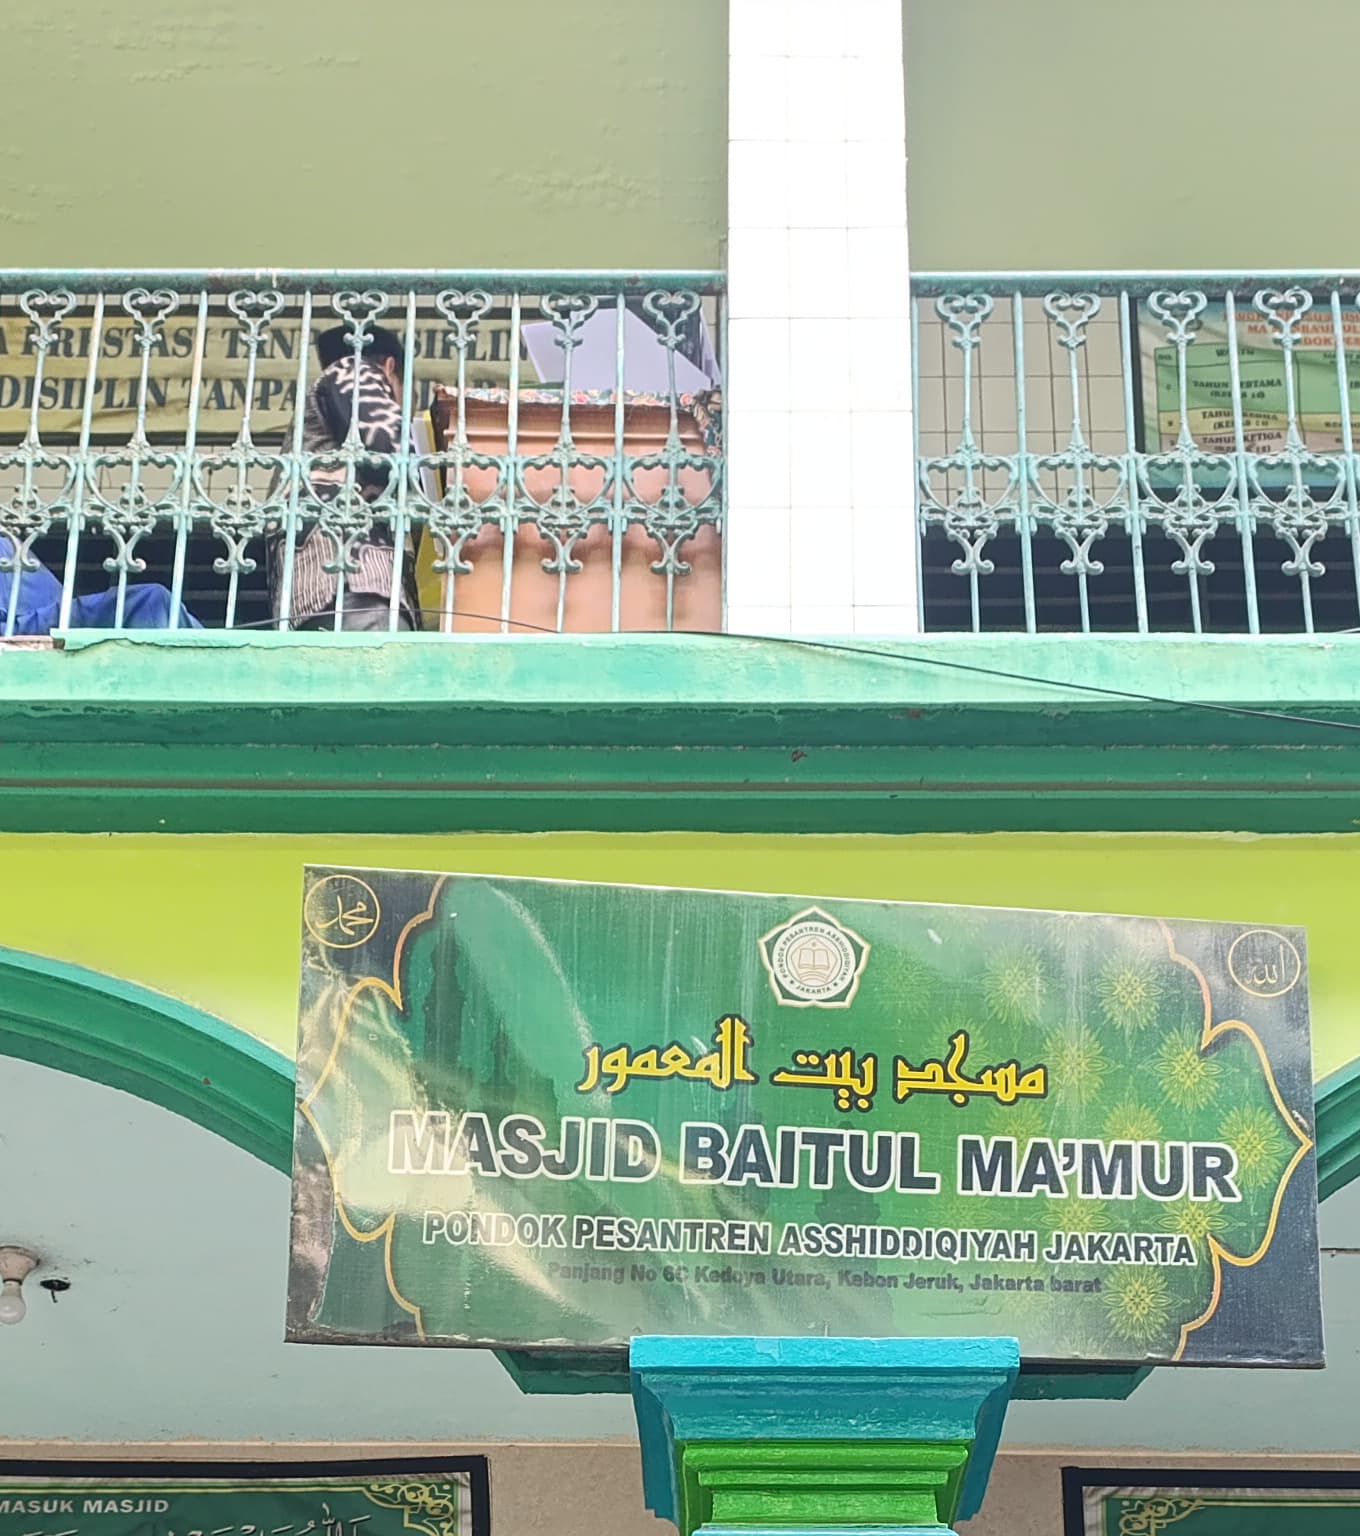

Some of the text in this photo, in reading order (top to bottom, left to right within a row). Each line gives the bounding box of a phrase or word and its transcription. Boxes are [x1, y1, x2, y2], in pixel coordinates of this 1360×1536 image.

[1234, 377, 1283, 388] ERTAMA
[796, 985, 832, 994] JAKARTA
[576, 1014, 1048, 1111] مسجد بيت المعمور
[388, 1110, 661, 1182] MASJID
[679, 1120, 941, 1194] BAITUL
[423, 1210, 1198, 1266] PONDOK PESANTREN ASSHIDDIQIYAH JAKARTA
[547, 1261, 625, 1284] Panjang
[630, 1263, 657, 1283] No
[694, 1265, 767, 1287] Kedoya
[772, 1268, 832, 1290] Utara,
[838, 1269, 899, 1289] Kebon
[902, 1272, 965, 1294] Jeruk,
[969, 1273, 1046, 1293] Jakarta
[1051, 1275, 1103, 1294] barat
[83, 1499, 170, 1514] MASJID
